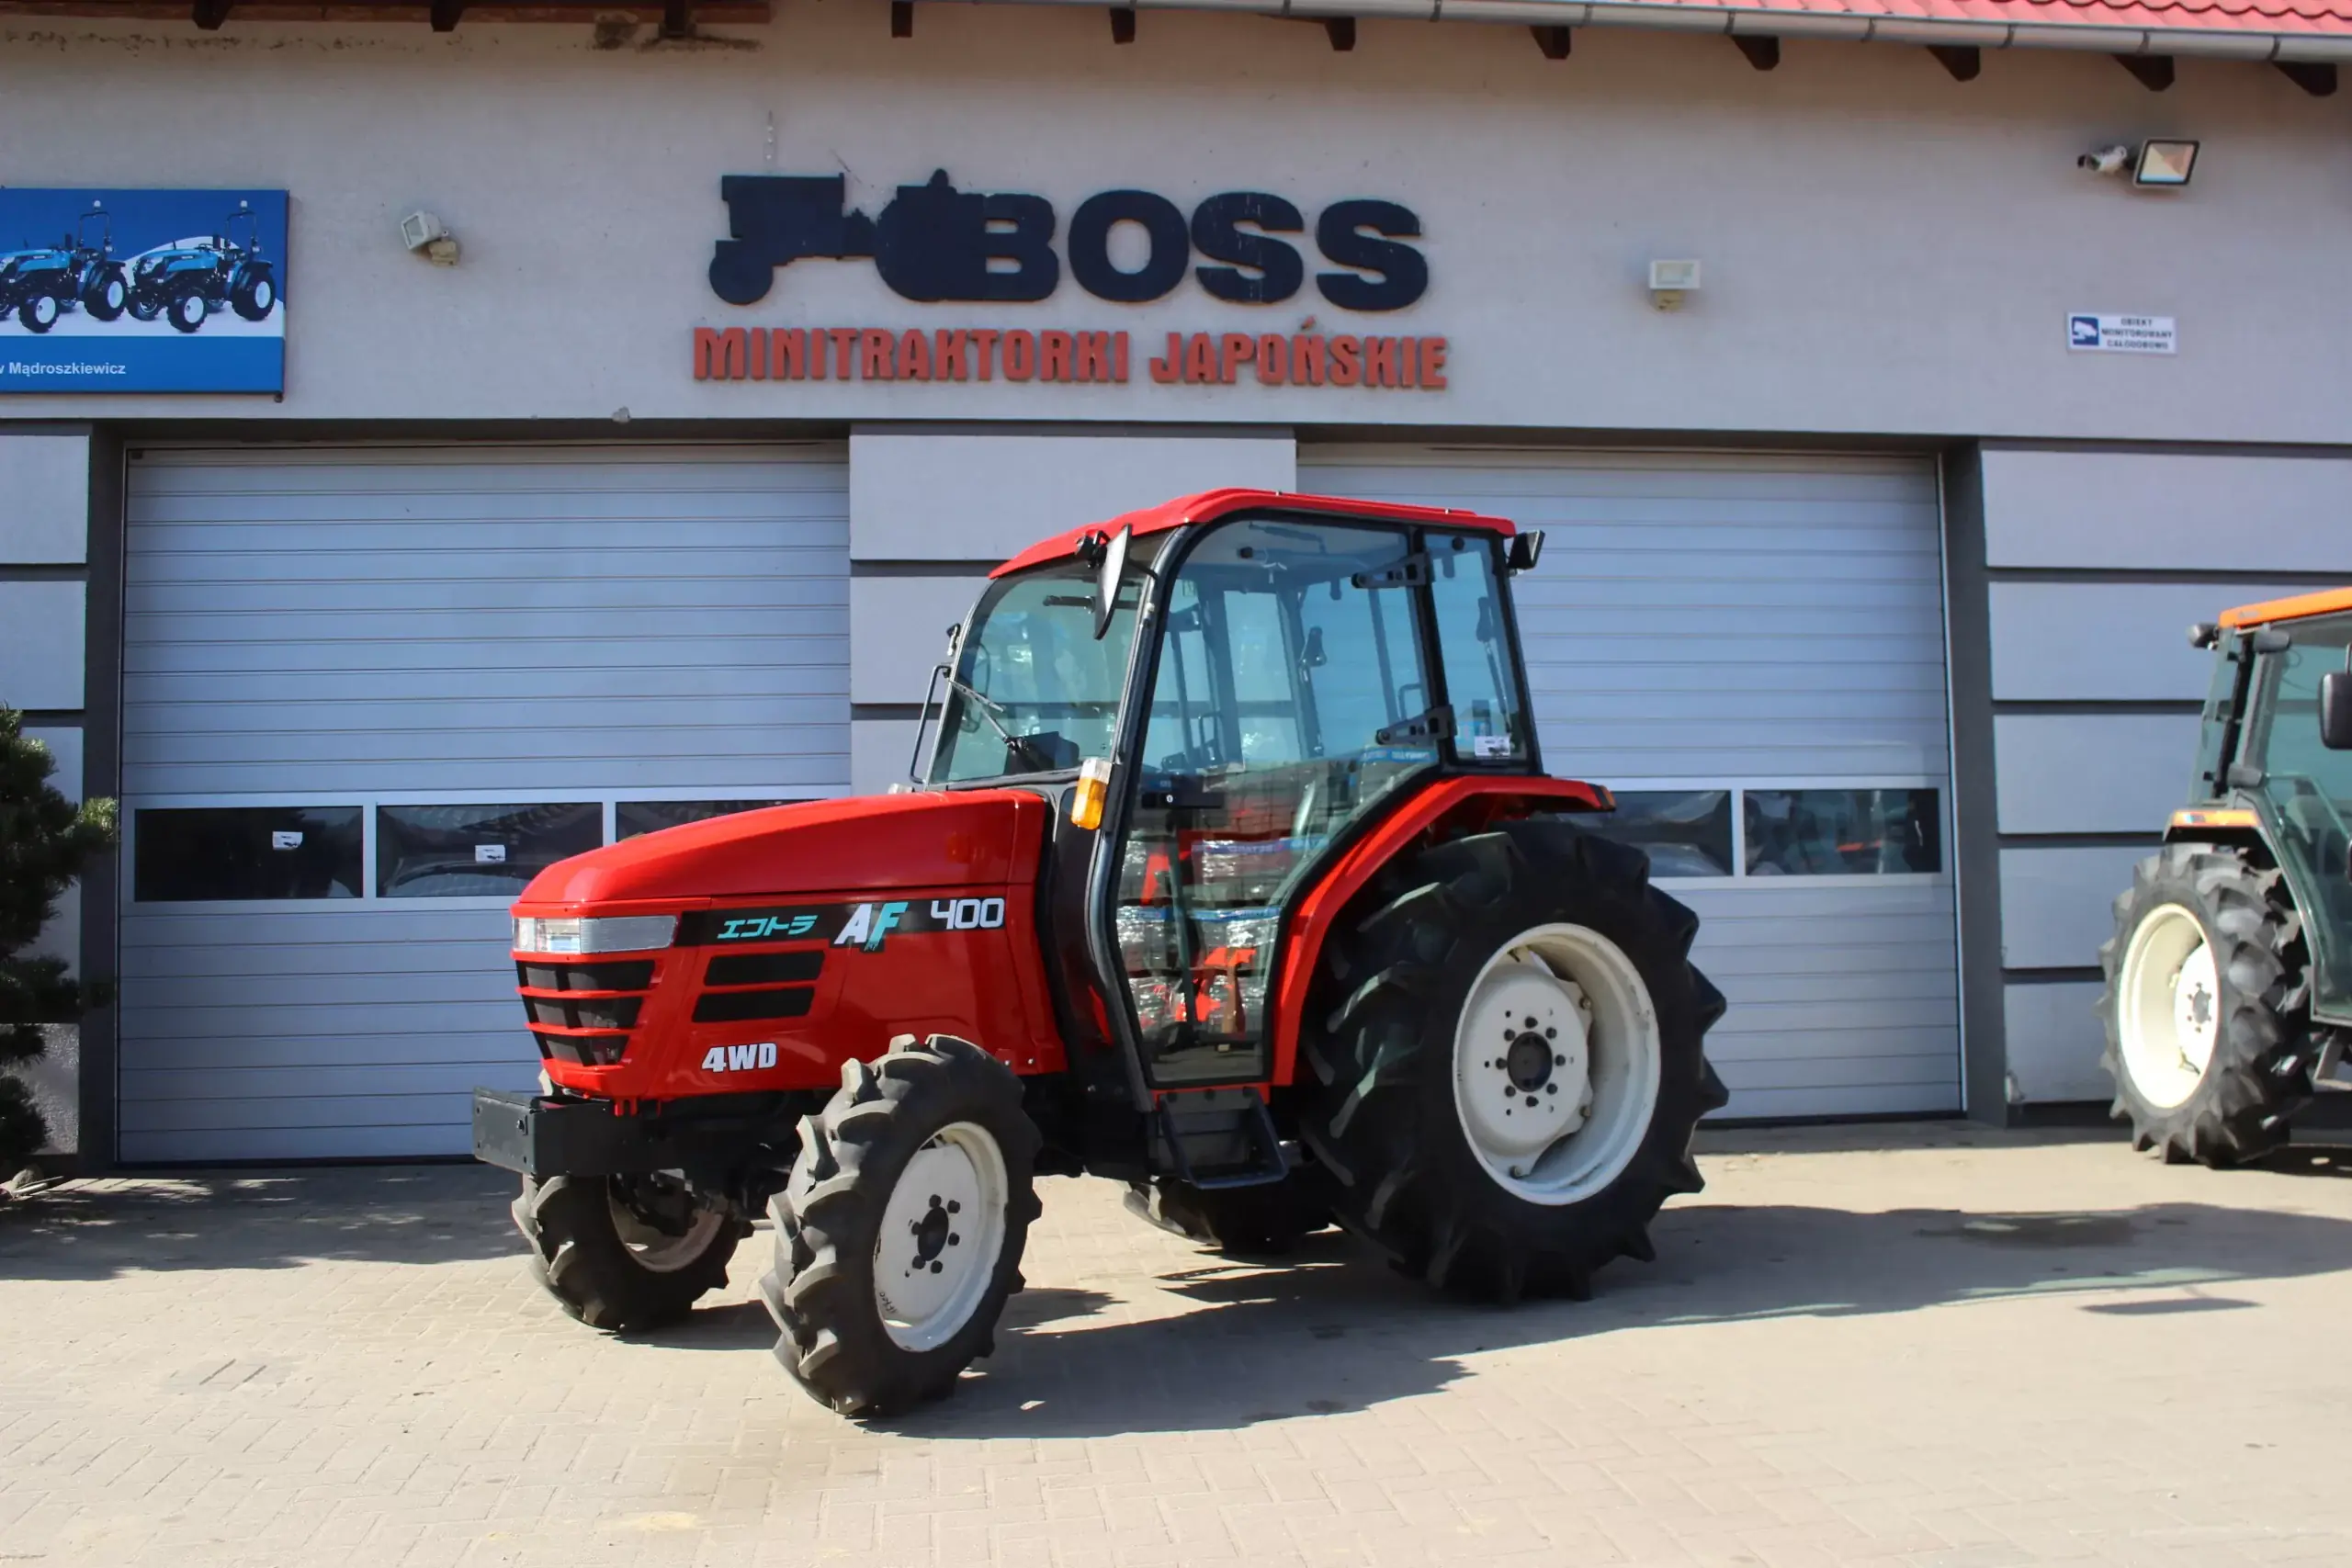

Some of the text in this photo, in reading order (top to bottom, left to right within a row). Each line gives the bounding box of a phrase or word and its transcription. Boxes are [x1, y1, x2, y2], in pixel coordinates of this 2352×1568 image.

[954, 189, 1429, 310] BOSS
[693, 315, 1448, 389] MINITRAKTORKI JAPOŃSKIE
[2101, 328, 2172, 338] MONITOROWANY
[9, 362, 127, 378] Mądroszkiewicz
[717, 897, 1005, 952] エコトラ AF 400
[701, 1043, 778, 1073] 4WD
